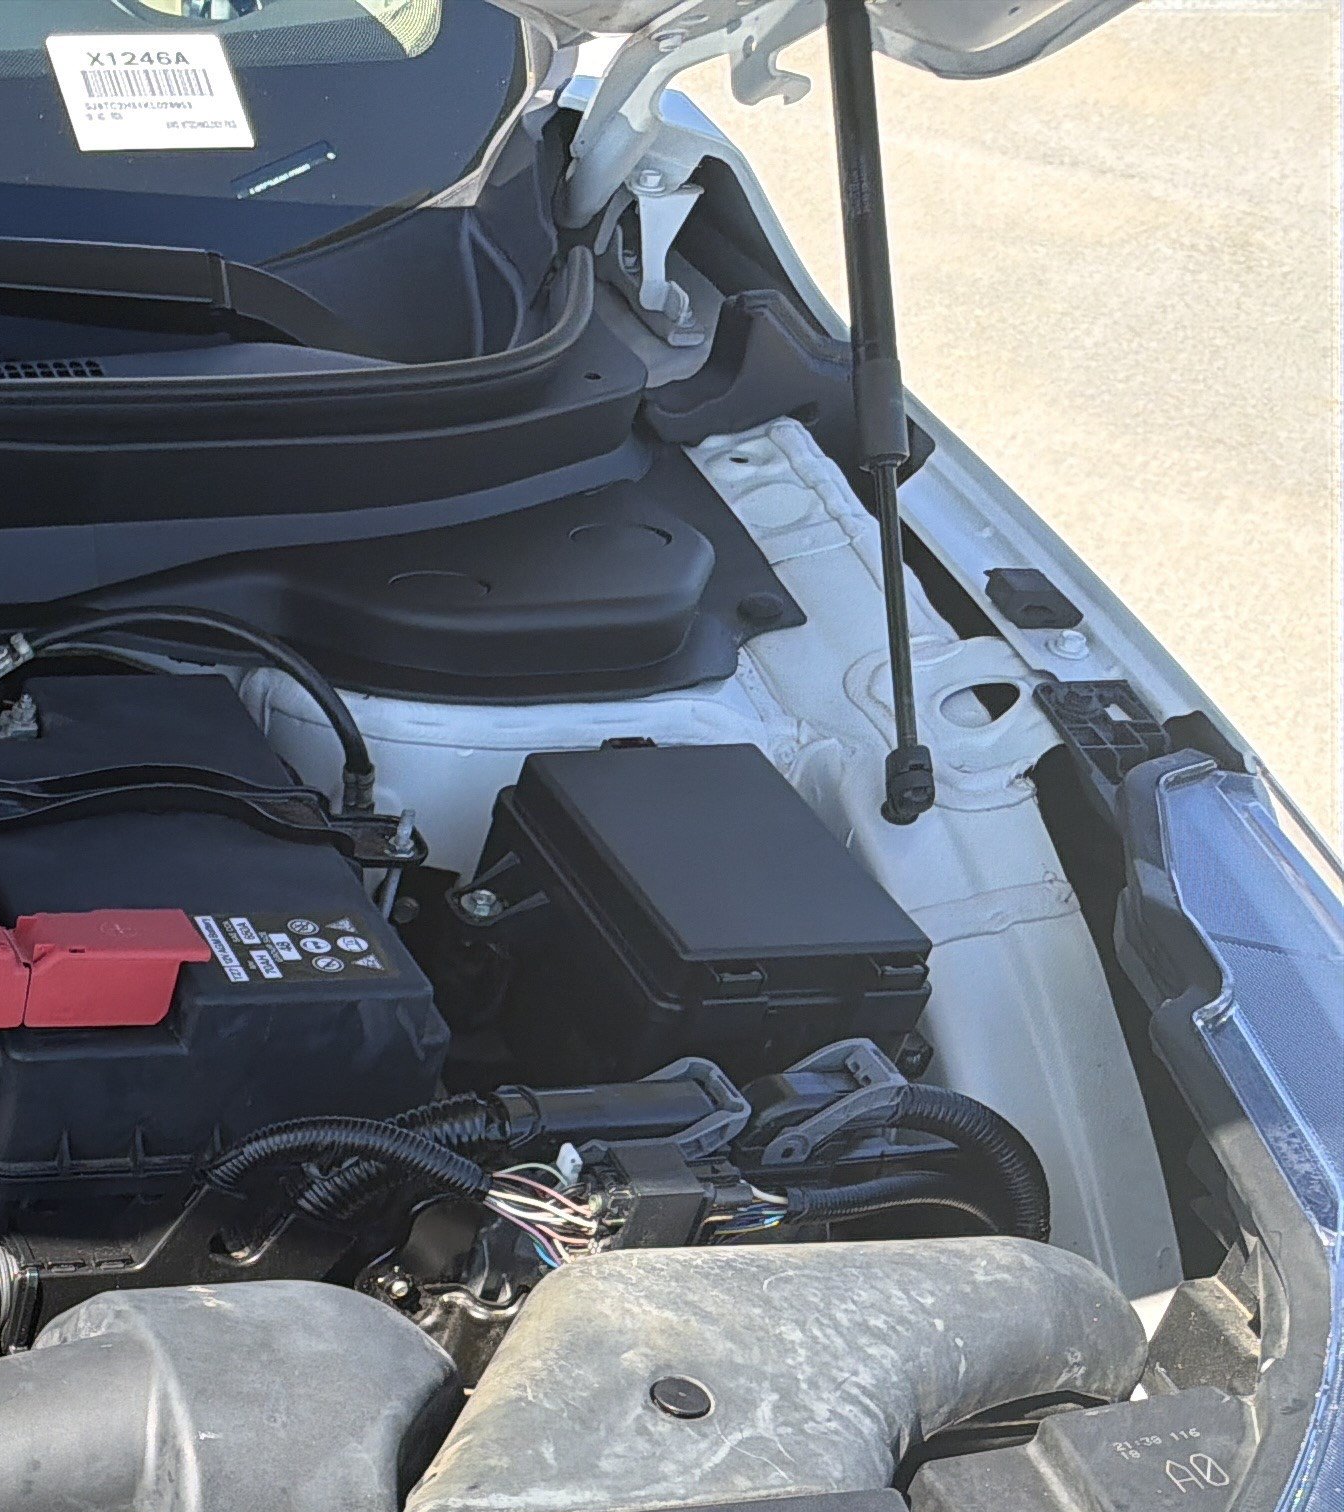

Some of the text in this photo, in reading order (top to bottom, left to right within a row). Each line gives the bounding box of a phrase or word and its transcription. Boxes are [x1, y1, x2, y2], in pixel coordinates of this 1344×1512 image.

[86, 52, 190, 66] X1246A
[1170, 1428, 1201, 1441] 116
[1120, 1449, 1141, 1460] 18
